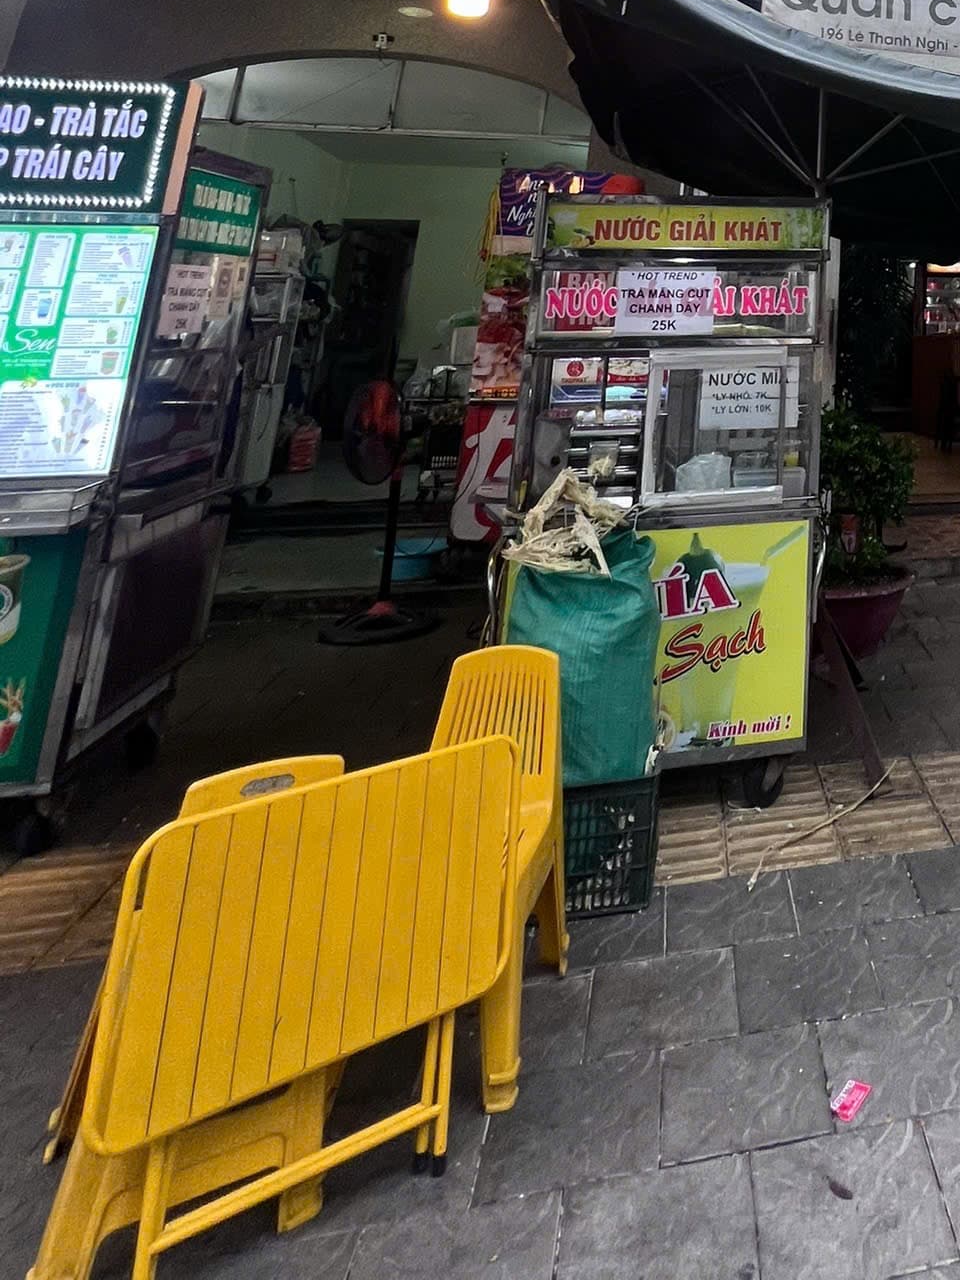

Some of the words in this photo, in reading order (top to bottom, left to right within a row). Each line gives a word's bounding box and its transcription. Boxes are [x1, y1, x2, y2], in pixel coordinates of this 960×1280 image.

[820, 27, 844, 41] 196
[848, 28, 864, 42] Lê
[869, 31, 912, 48] Thanh
[50, 100, 97, 137] TRÀ
[101, 99, 148, 139] TẮC
[12, 143, 72, 179] TRÁI
[72, 145, 125, 181] CÂY
[594, 215, 661, 242] NƯỚC
[670, 213, 716, 242] GIẢI
[724, 216, 782, 242] KHÁT
[637, 272, 660, 280] HOT
[663, 272, 698, 280] TREND
[545, 278, 617, 319] NƯỚC
[740, 277, 809, 316] KHÁT
[629, 303, 672, 314] CHANH
[652, 320, 676, 331] 25K
[709, 370, 756, 387] NƯỚC
[652, 562, 741, 620] ÍA
[653, 608, 767, 685] Sạch
[707, 719, 747, 740] Kính
[752, 715, 782, 735] mời
